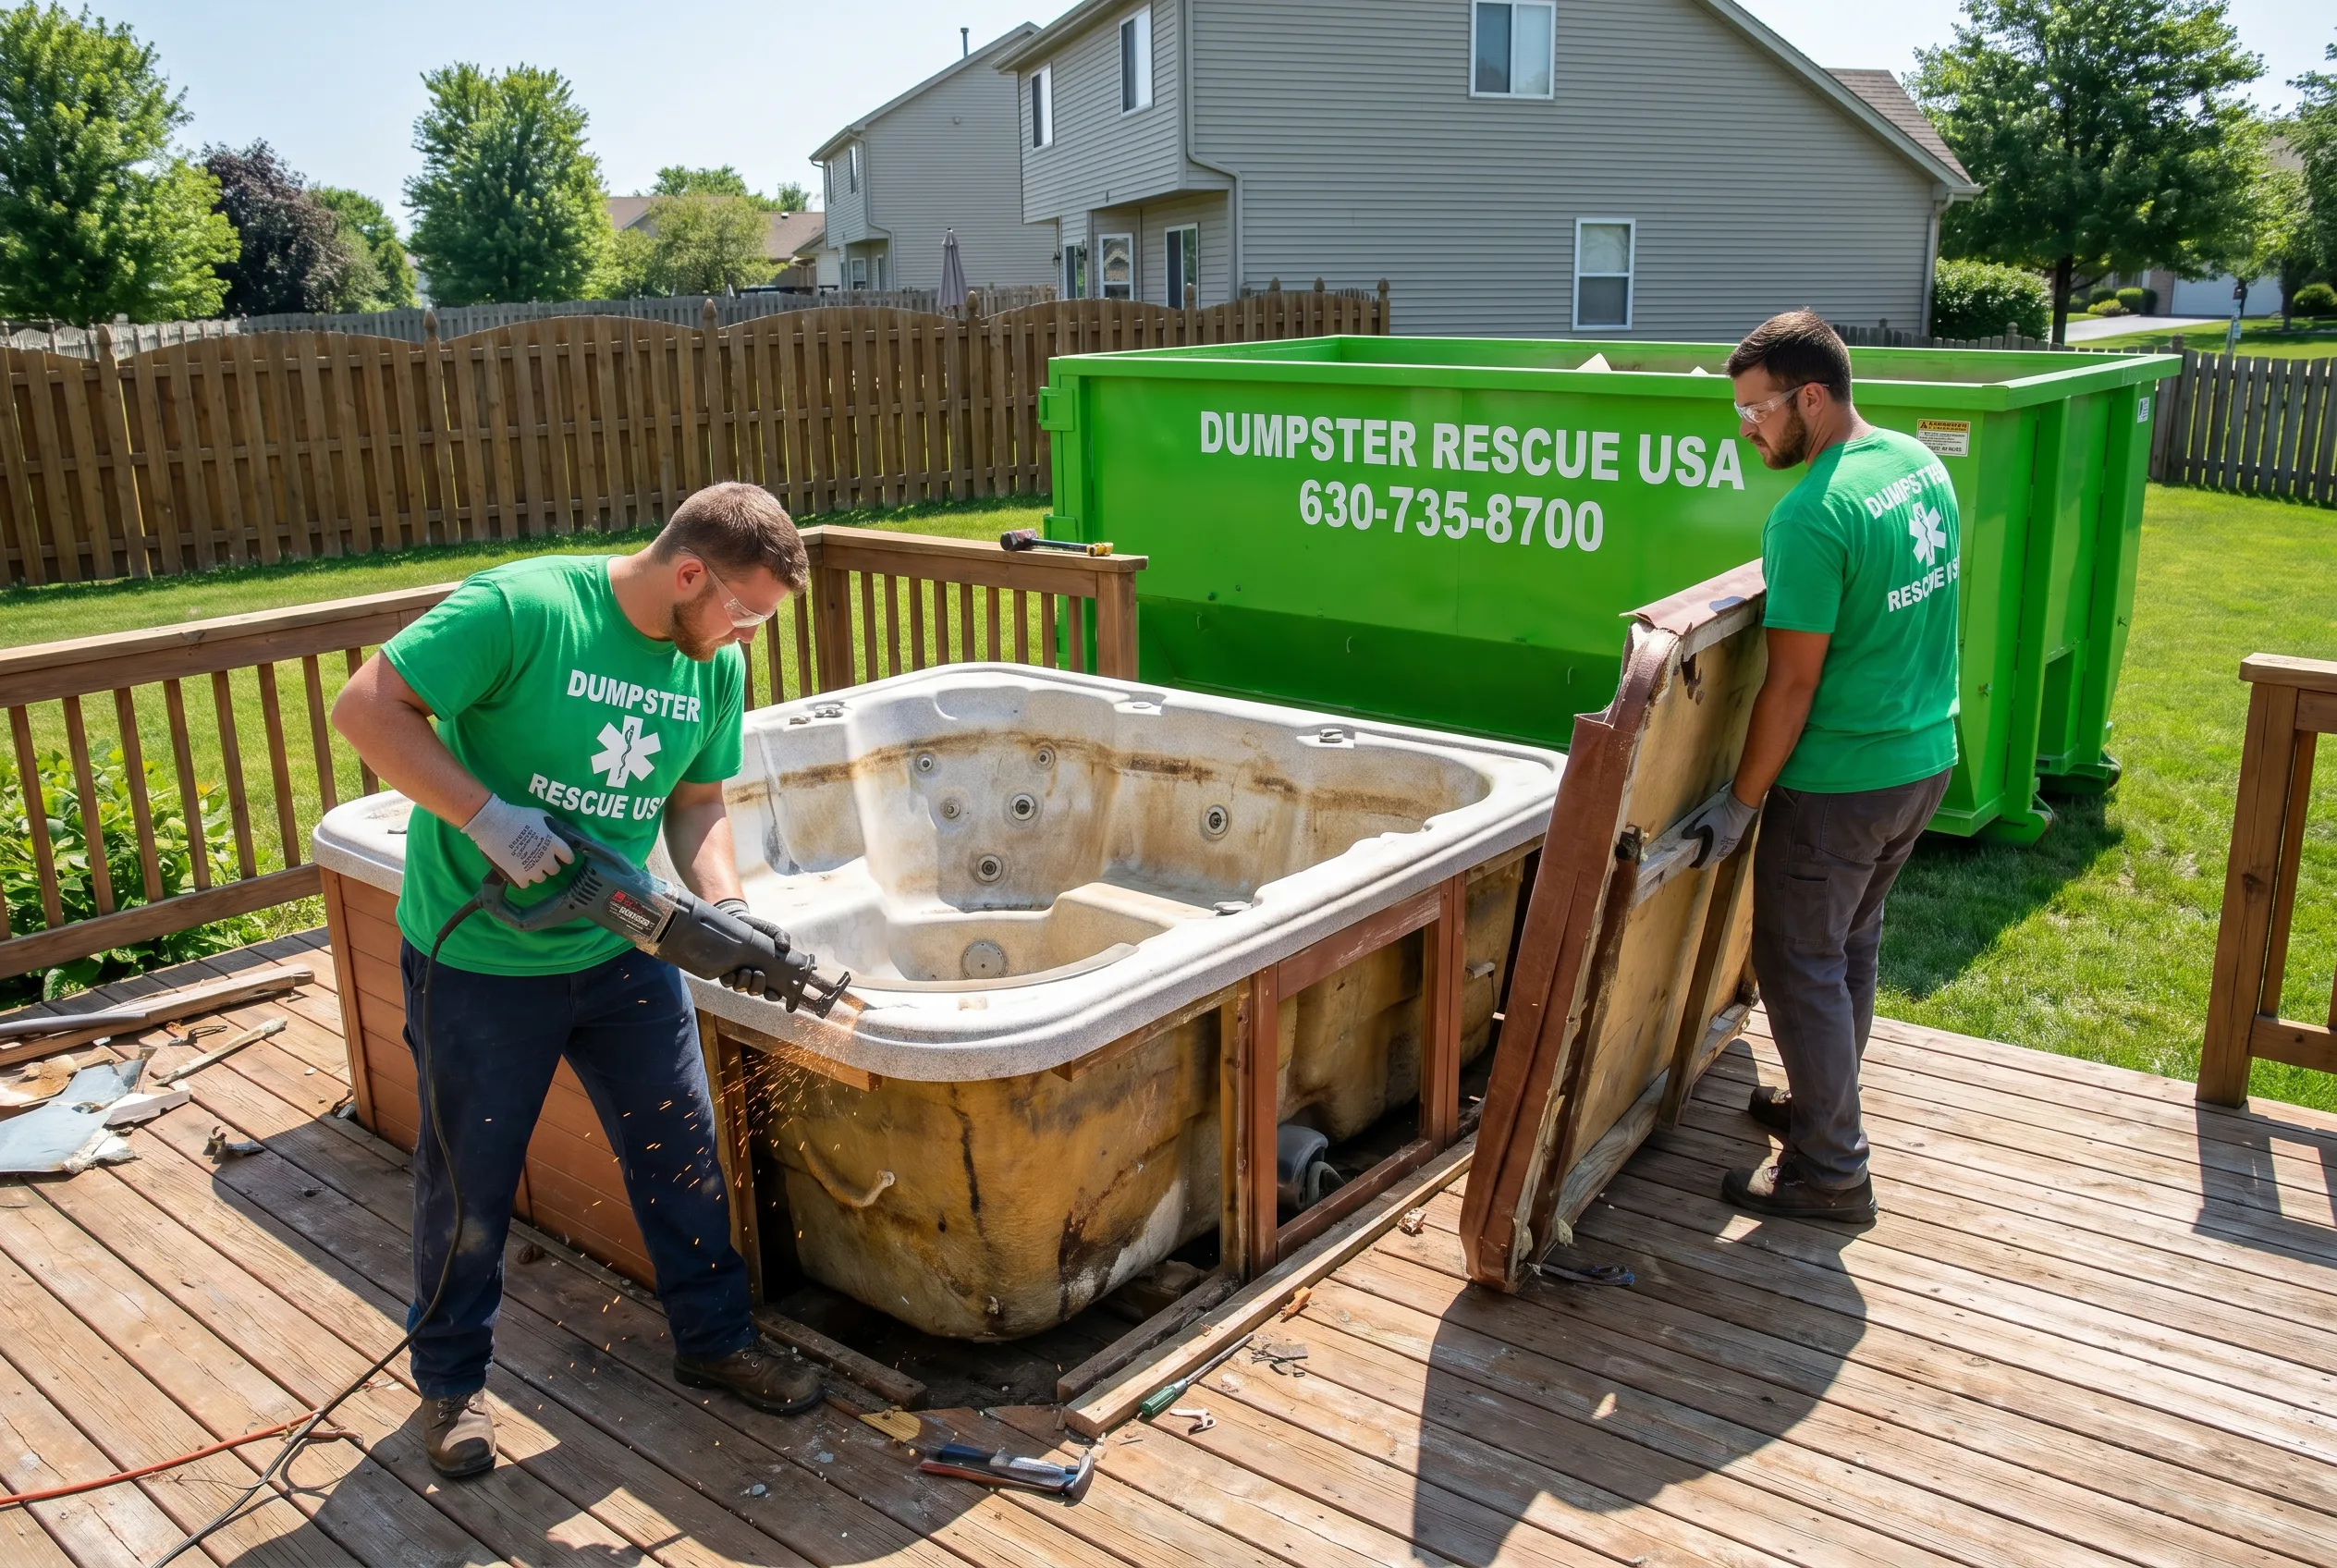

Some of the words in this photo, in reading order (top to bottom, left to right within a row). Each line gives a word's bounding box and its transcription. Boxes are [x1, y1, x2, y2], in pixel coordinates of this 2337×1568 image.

[1201, 410, 1418, 468] DUMPSTER
[1432, 423, 1621, 482] RESCUE
[1638, 434, 1745, 491] USA
[1299, 479, 1604, 552] 630-735-8700
[567, 668, 701, 723] DUMPSTER
[528, 773, 630, 820] RESCUE
